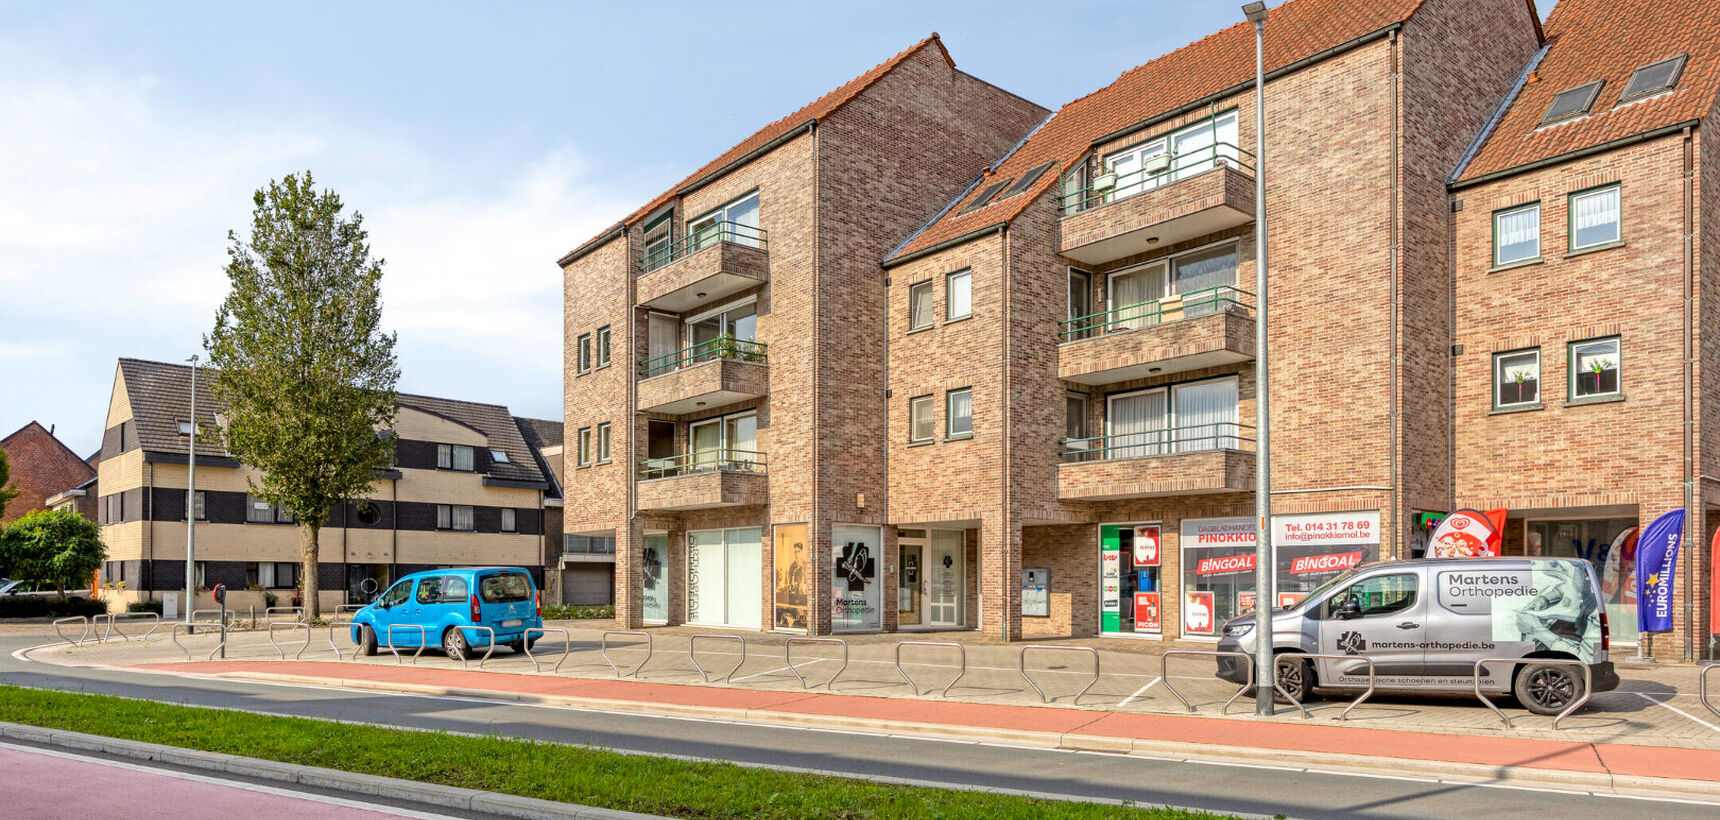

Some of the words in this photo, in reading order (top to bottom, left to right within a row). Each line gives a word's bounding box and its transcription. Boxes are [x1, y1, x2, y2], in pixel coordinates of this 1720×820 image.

[1198, 523, 1256, 533] DAGBLADHANDE
[1285, 524, 1303, 532] Tel.
[1305, 523, 1323, 531] 014
[1326, 522, 1338, 530] 31
[1341, 521, 1354, 529] 78
[1356, 520, 1370, 529] 69
[1198, 532, 1256, 543] PINOKKIO
[1285, 530, 1371, 541] info@pinokkiomol.be
[1449, 574, 1519, 585] Martens
[1656, 533, 1678, 618] EUROMILLIONS
[1449, 586, 1538, 598] Orthopedie
[1372, 641, 1496, 650] martens-orthopedie.be
[1338, 676, 1396, 684] Orthopeische
